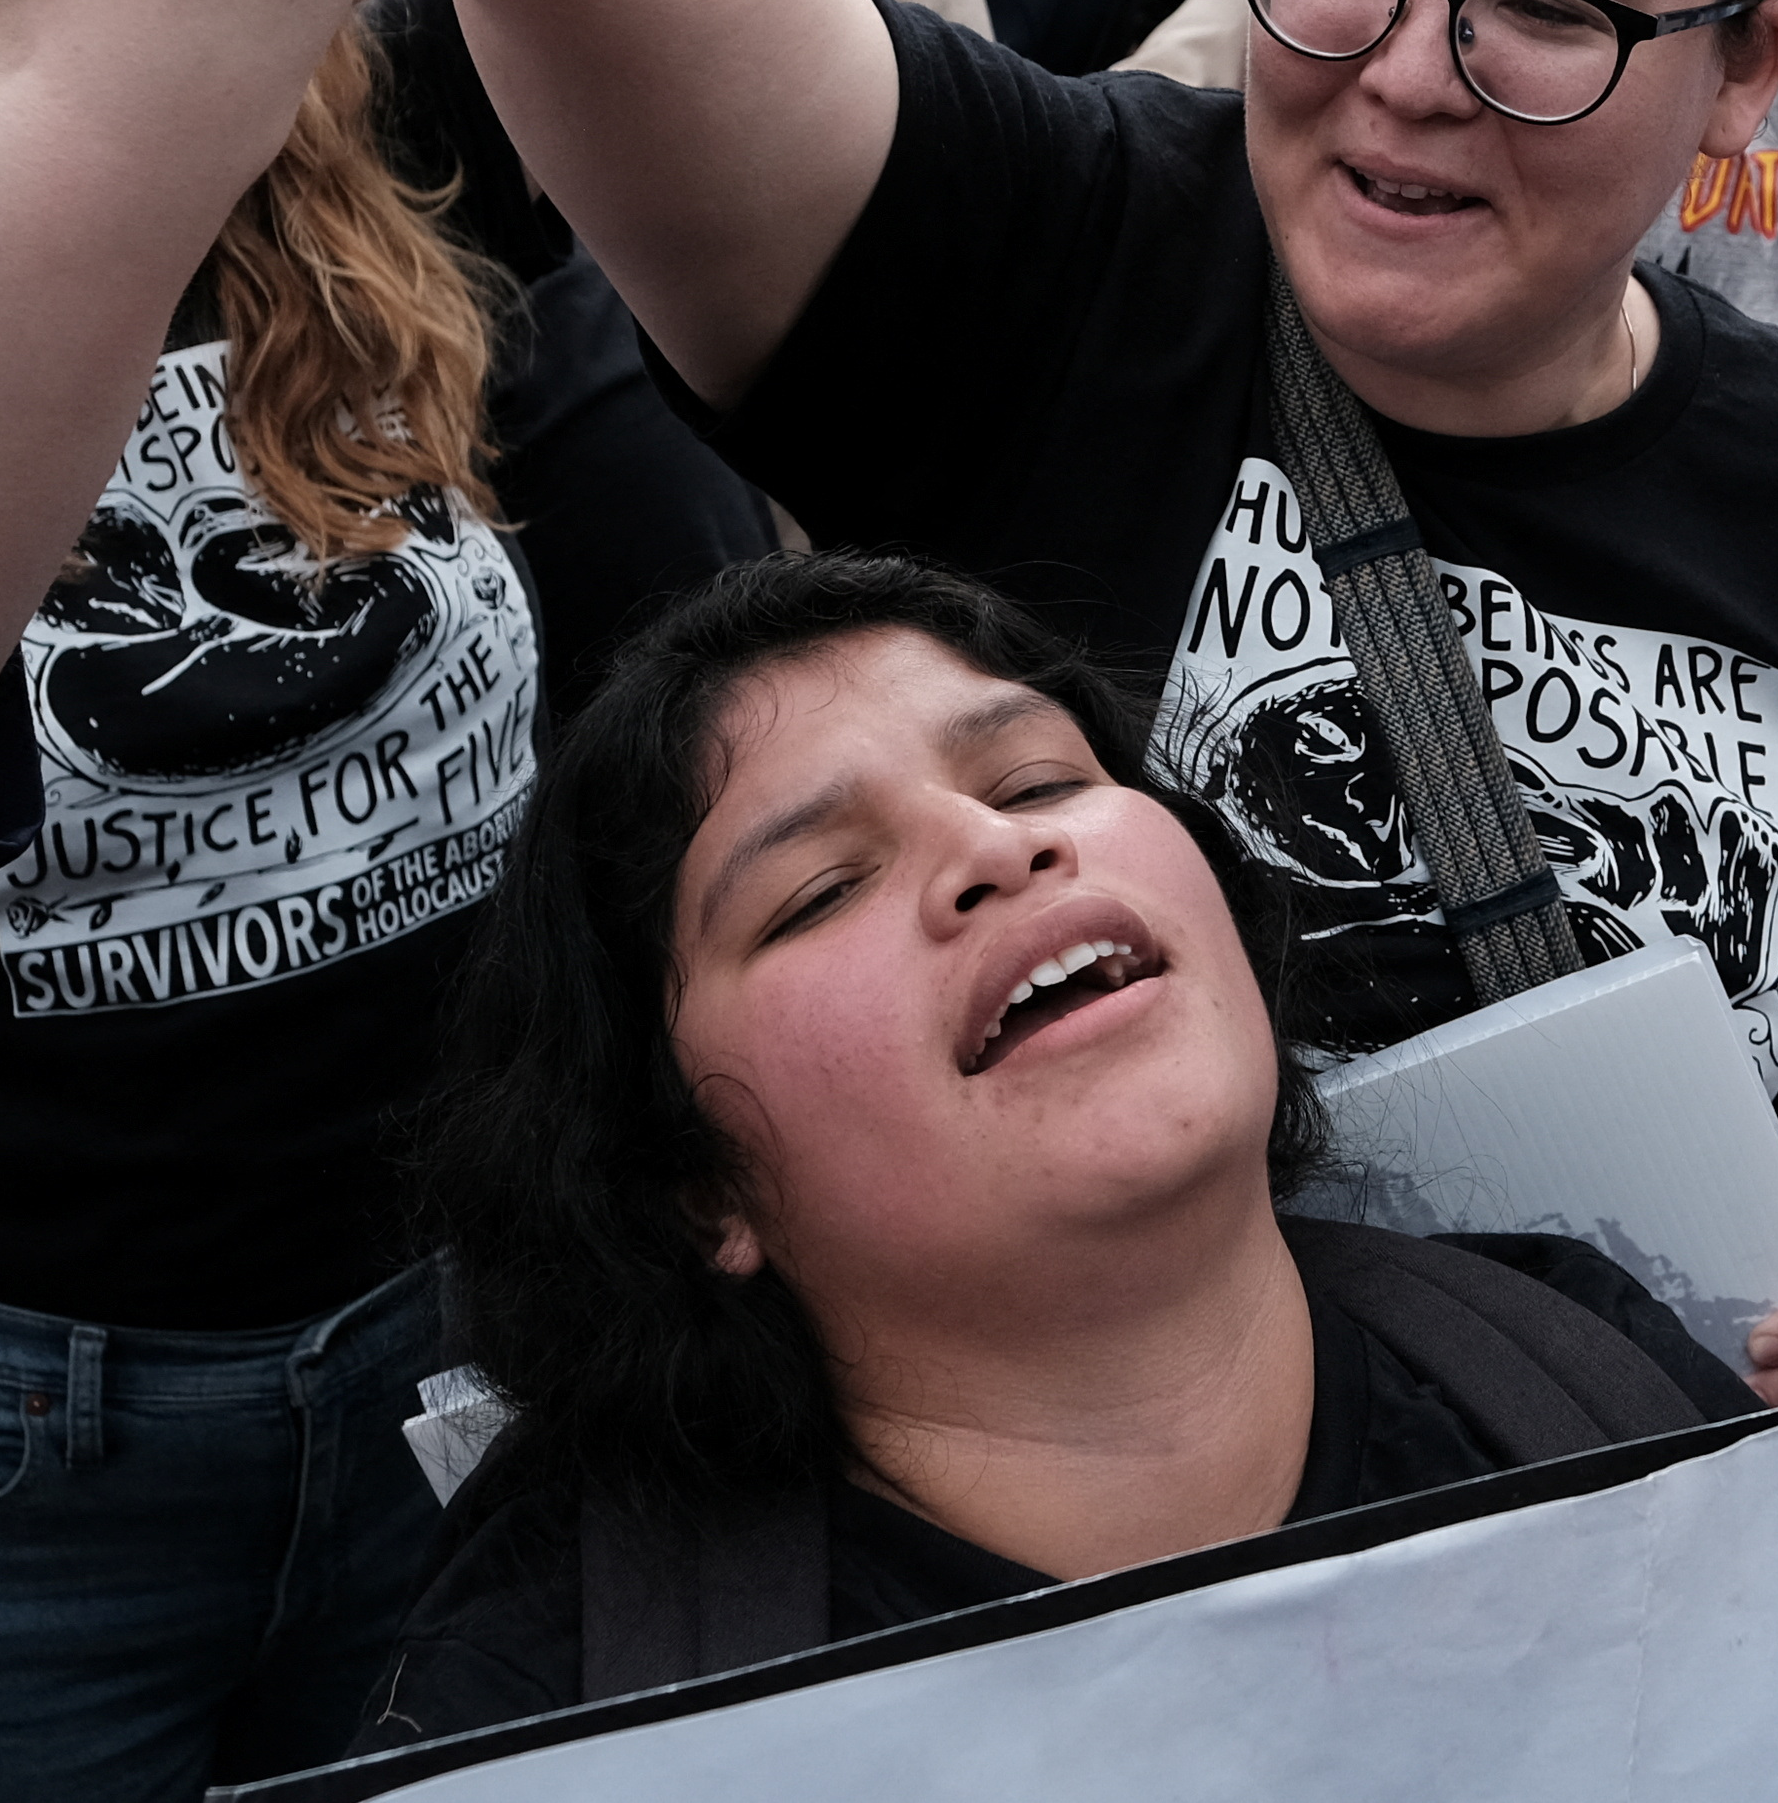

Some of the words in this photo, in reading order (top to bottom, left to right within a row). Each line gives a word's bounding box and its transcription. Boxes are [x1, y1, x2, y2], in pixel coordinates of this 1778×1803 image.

[435, 678, 530, 827] FIVE
[1656, 643, 1772, 724] ARE
[7, 788, 281, 890] JUSTICE
[299, 729, 420, 837] FOR
[420, 632, 501, 733] THE
[19, 882, 349, 1013] SURVIVORS
[355, 850, 507, 946] HOLOCAUST
[351, 861, 385, 908] OF
[389, 847, 442, 892] THE
